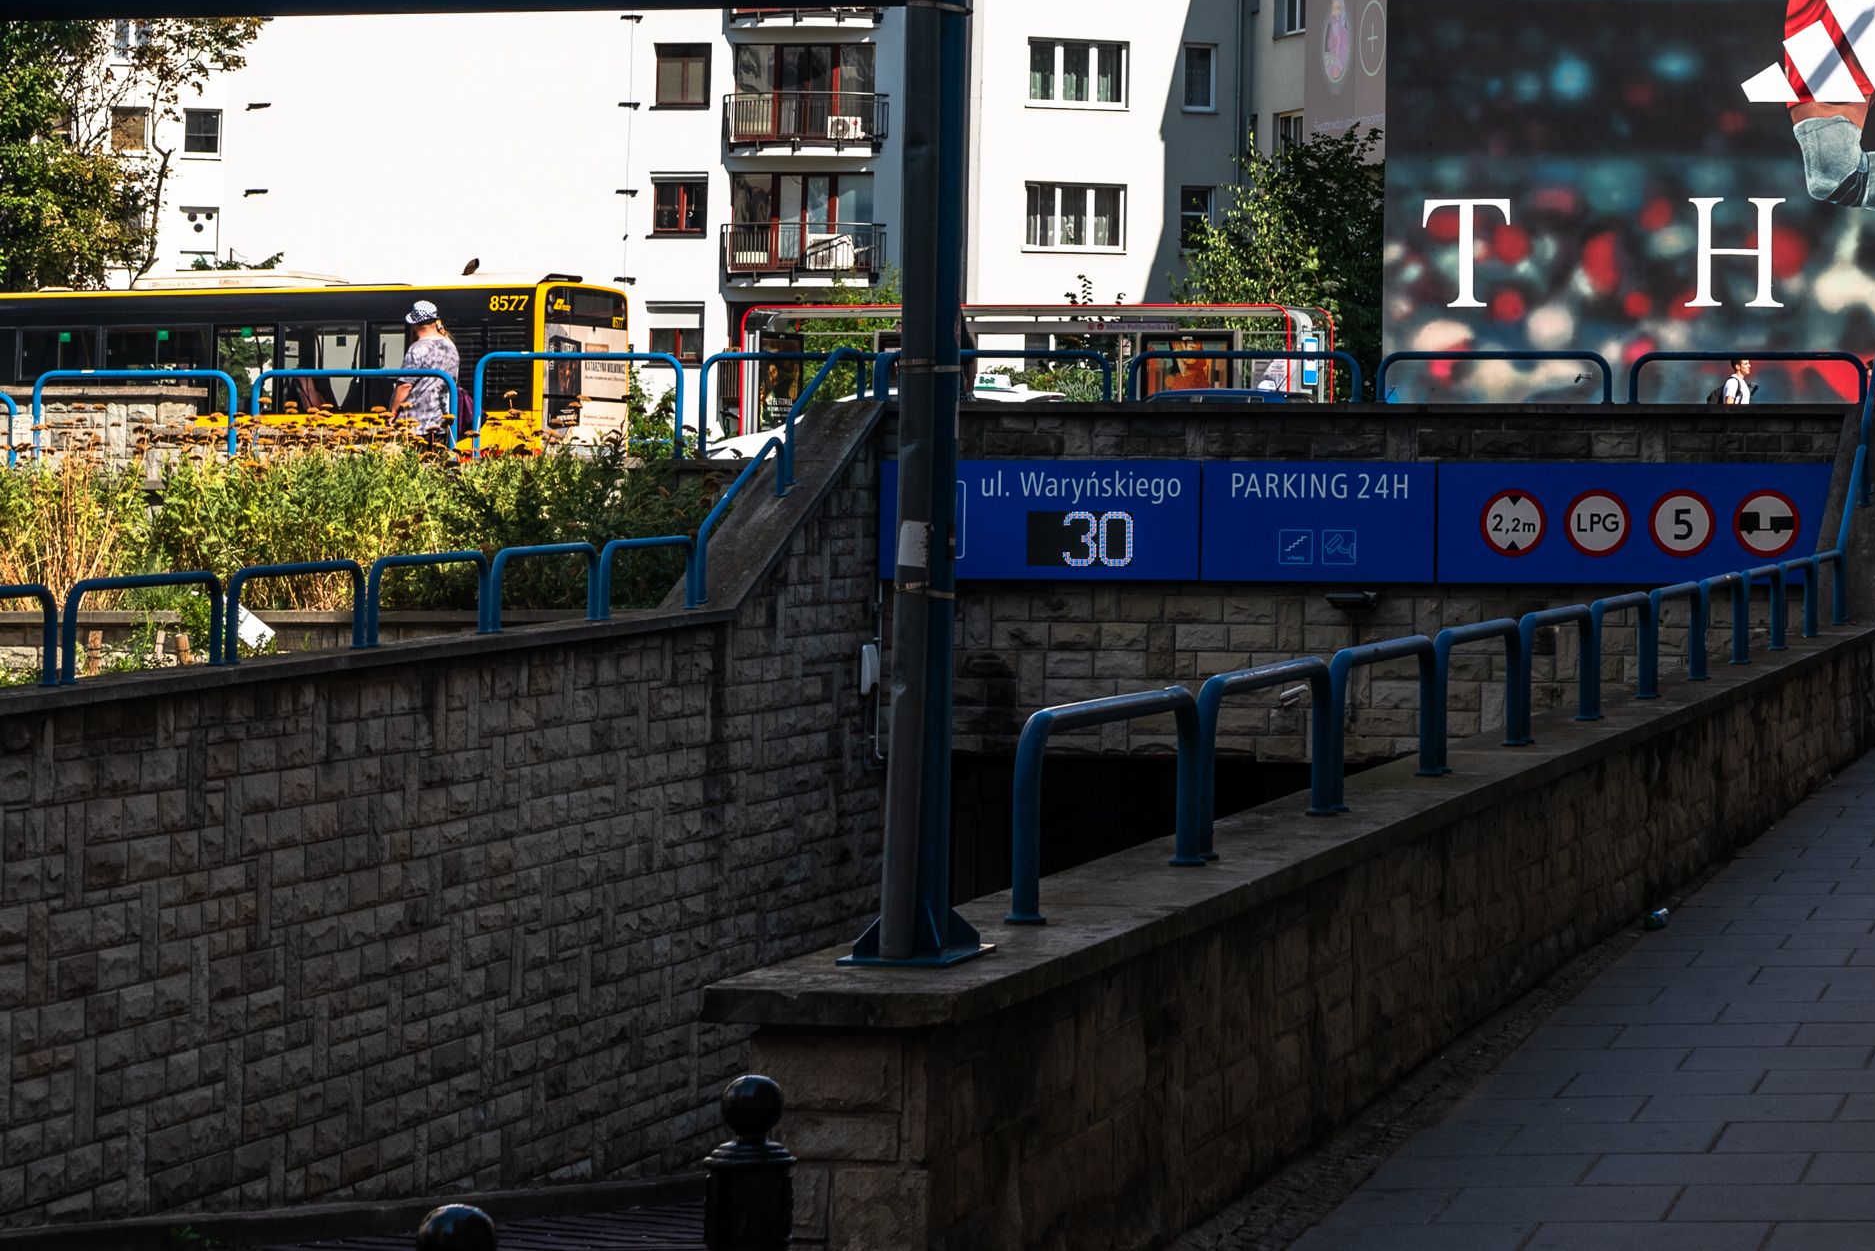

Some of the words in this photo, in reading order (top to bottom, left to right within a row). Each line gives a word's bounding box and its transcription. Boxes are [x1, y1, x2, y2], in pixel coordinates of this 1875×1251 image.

[489, 295, 529, 311] 8577
[979, 376, 996, 384] Bolt
[981, 469, 1010, 497] ul.
[1020, 469, 1182, 505] Waryńskiego
[1231, 472, 1348, 499] PARKING
[1357, 473, 1409, 500] 24H
[1491, 514, 1537, 535] 2,2m
[1577, 514, 1620, 533] LPG
[1674, 509, 1693, 541] 5
[1062, 511, 1134, 568] 30
